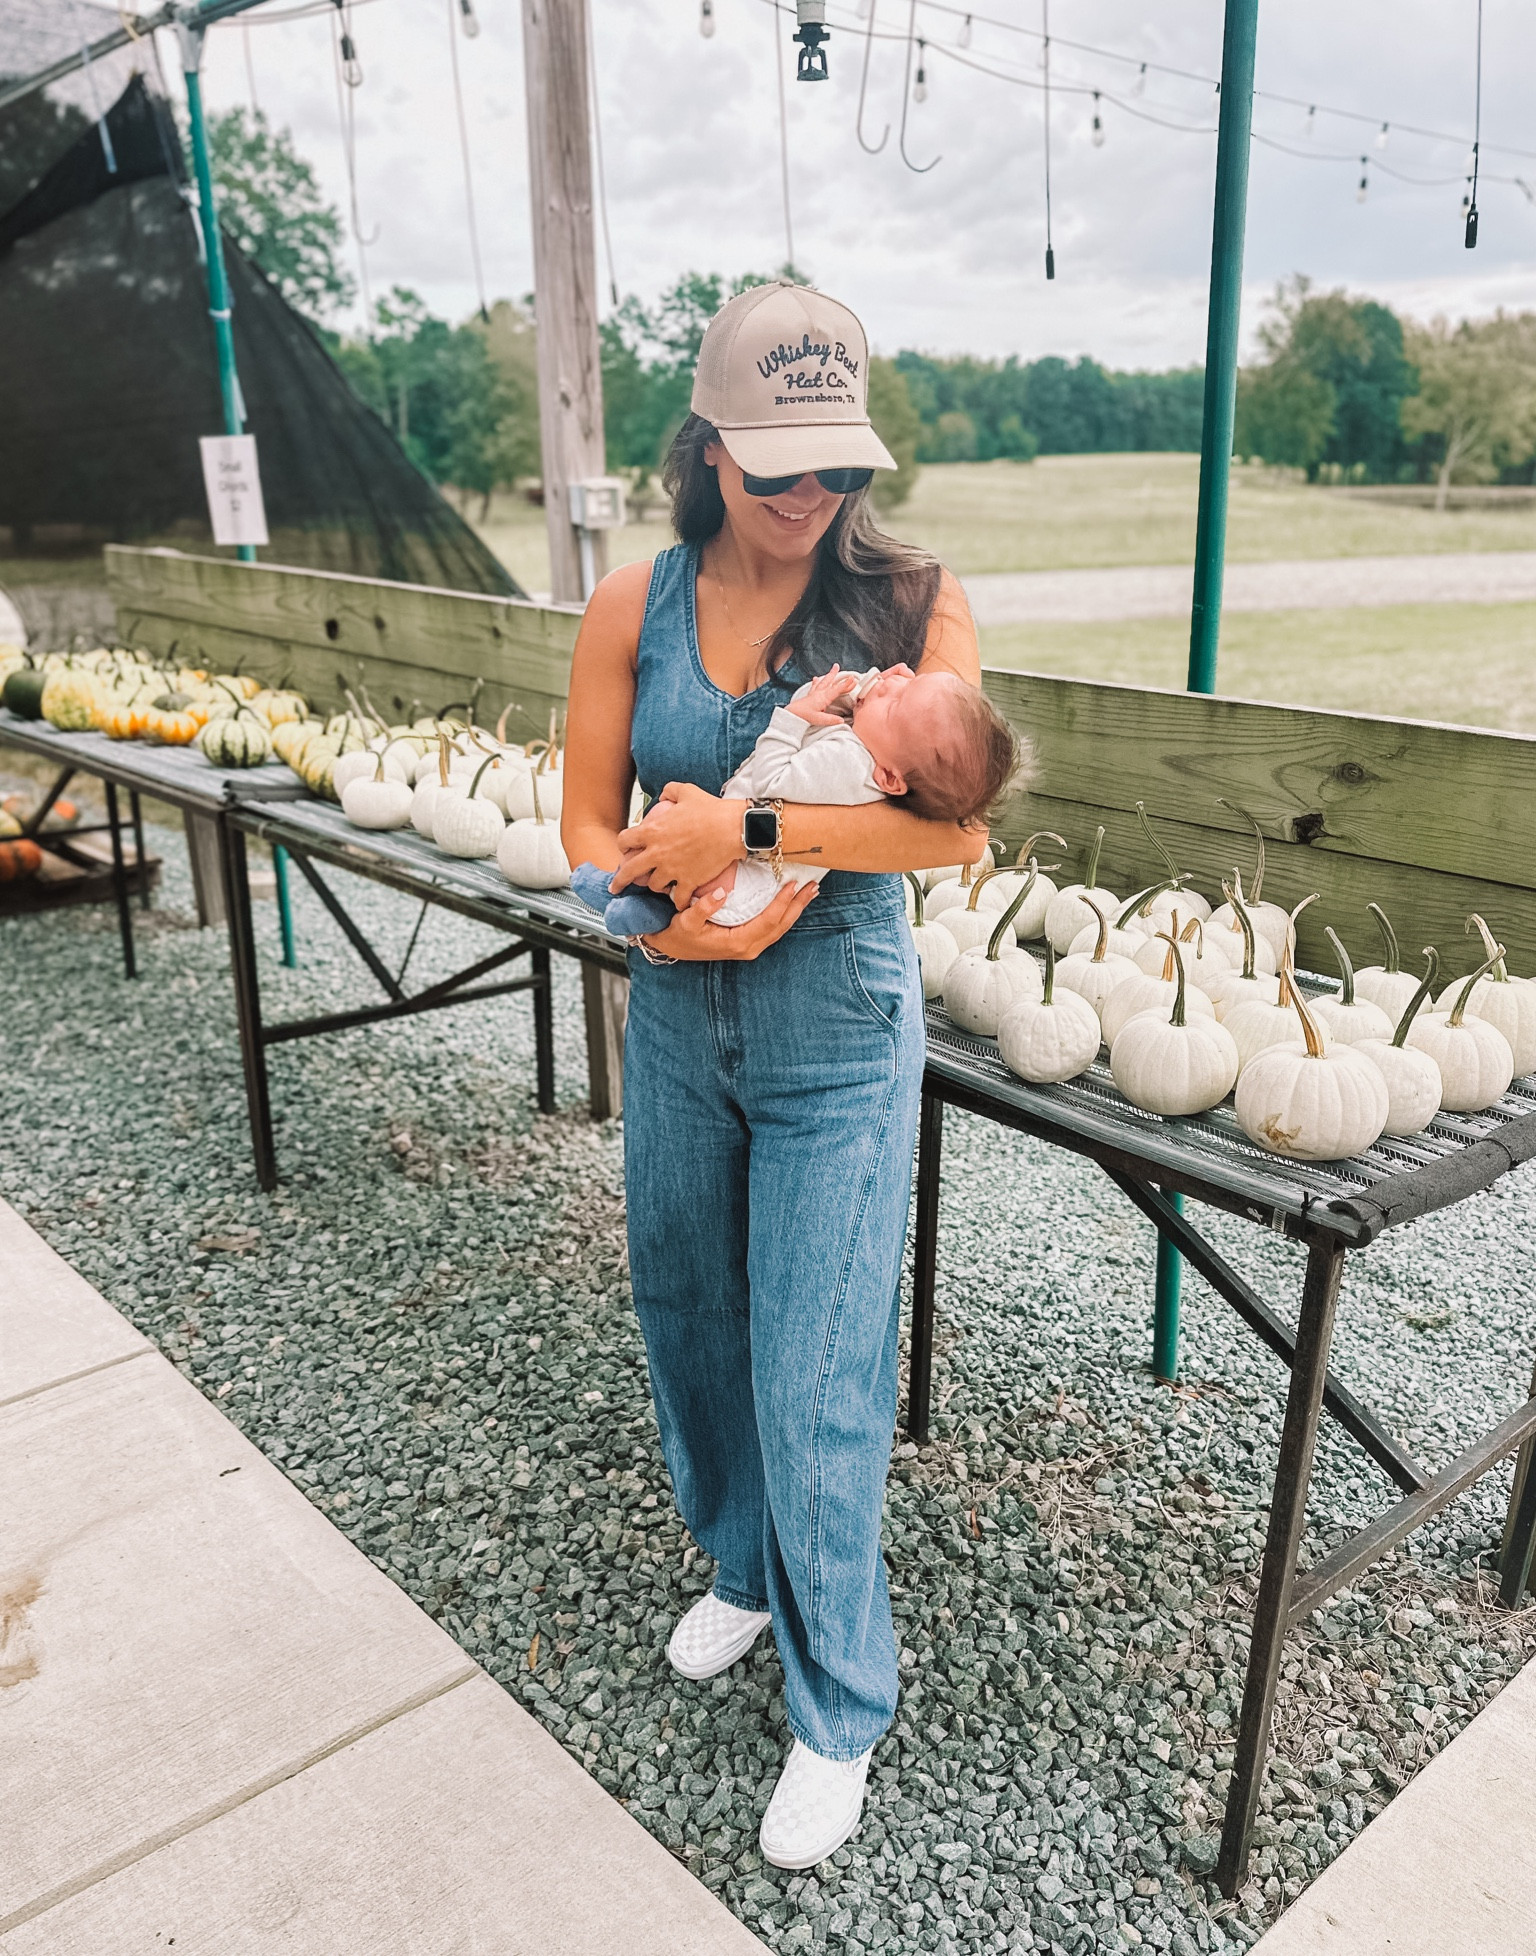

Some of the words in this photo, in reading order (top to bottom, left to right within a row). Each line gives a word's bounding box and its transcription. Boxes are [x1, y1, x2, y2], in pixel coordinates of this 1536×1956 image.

[757, 334, 831, 378] Whiskey
[784, 372, 823, 389] Hat
[826, 372, 847, 388] Co.
